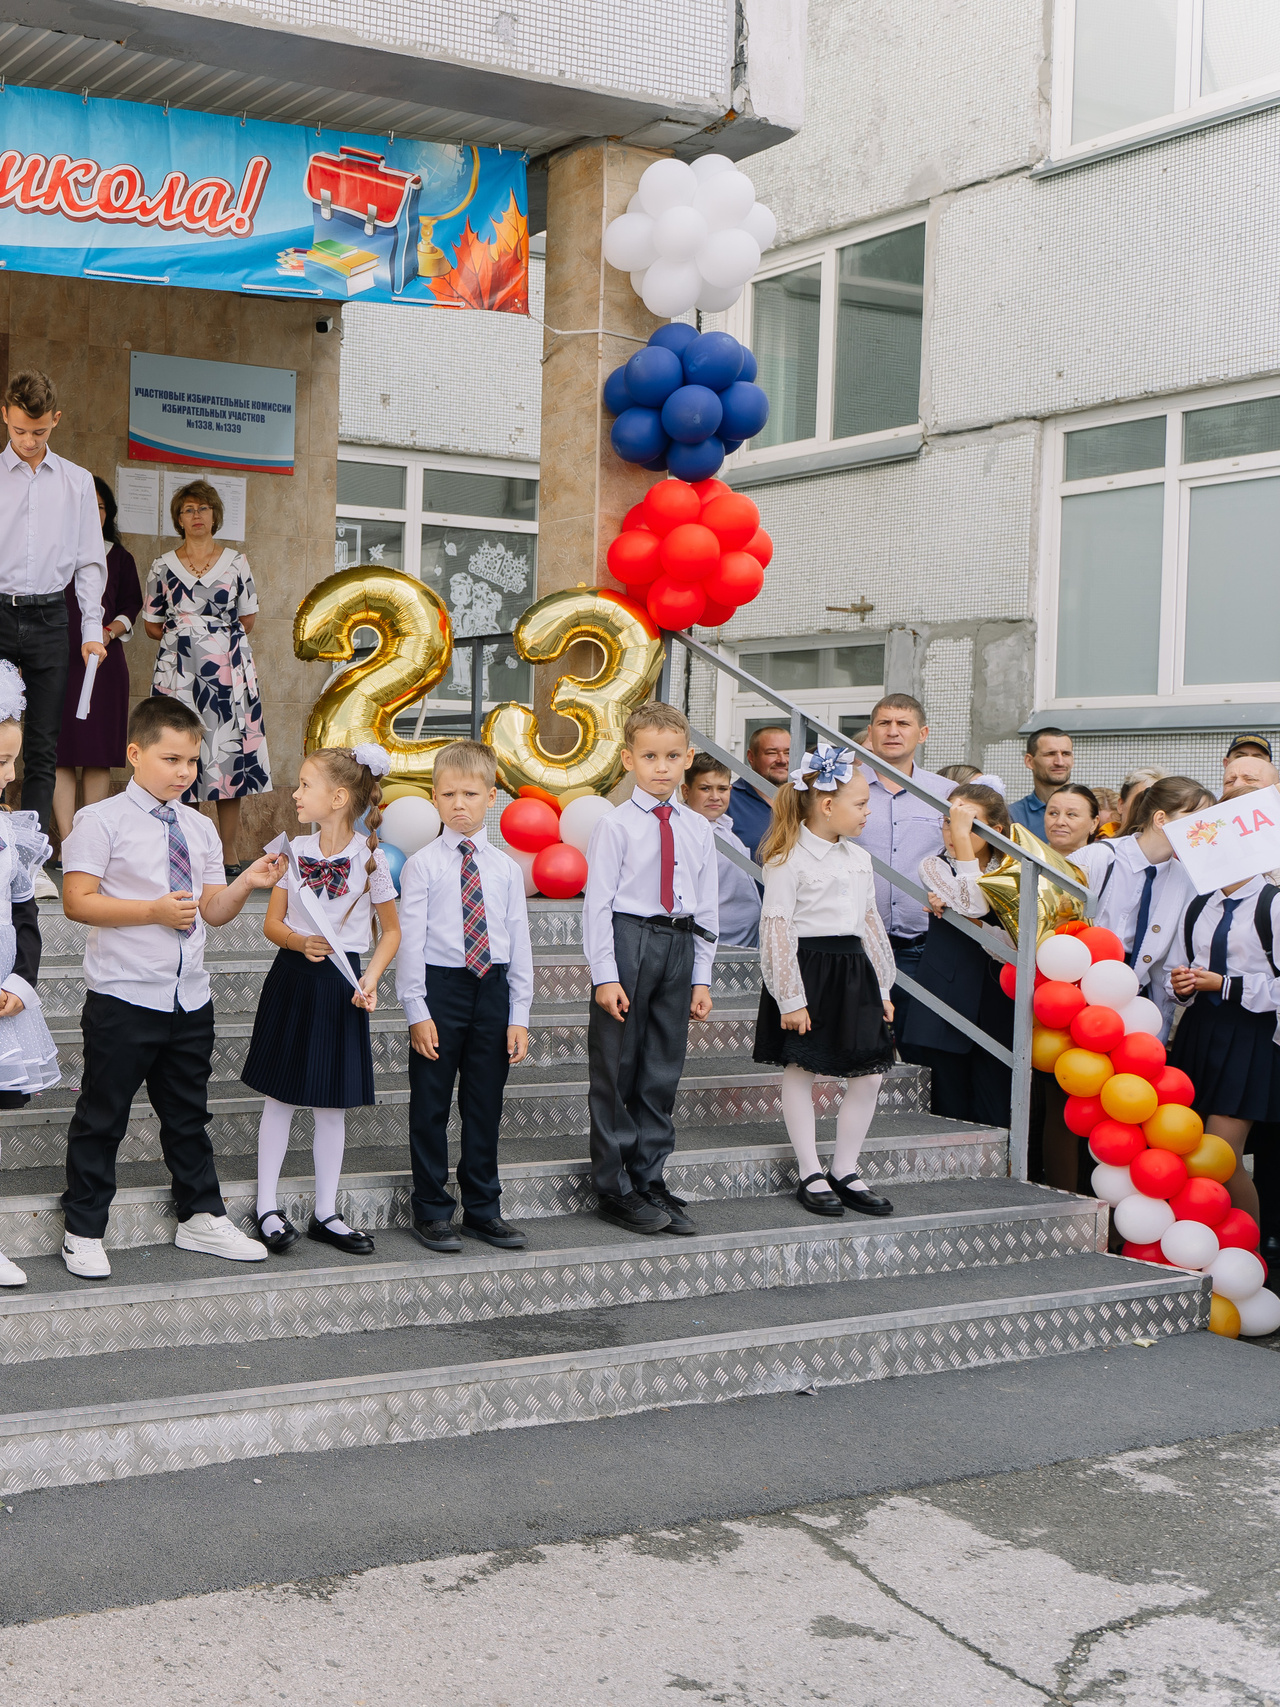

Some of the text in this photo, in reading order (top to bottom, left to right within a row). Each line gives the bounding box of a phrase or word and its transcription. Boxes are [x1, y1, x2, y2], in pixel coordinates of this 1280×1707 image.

[134, 386, 292, 414] УЧАСТКОВЫЕ ИЗБИРАТЕЛЬНЫЕ КОМИССИИ
[161, 403, 266, 424] ИЗБИРАТЕЛЬНЫХ УЧАСТКОВ
[186, 419, 242, 434] №1338, №1339
